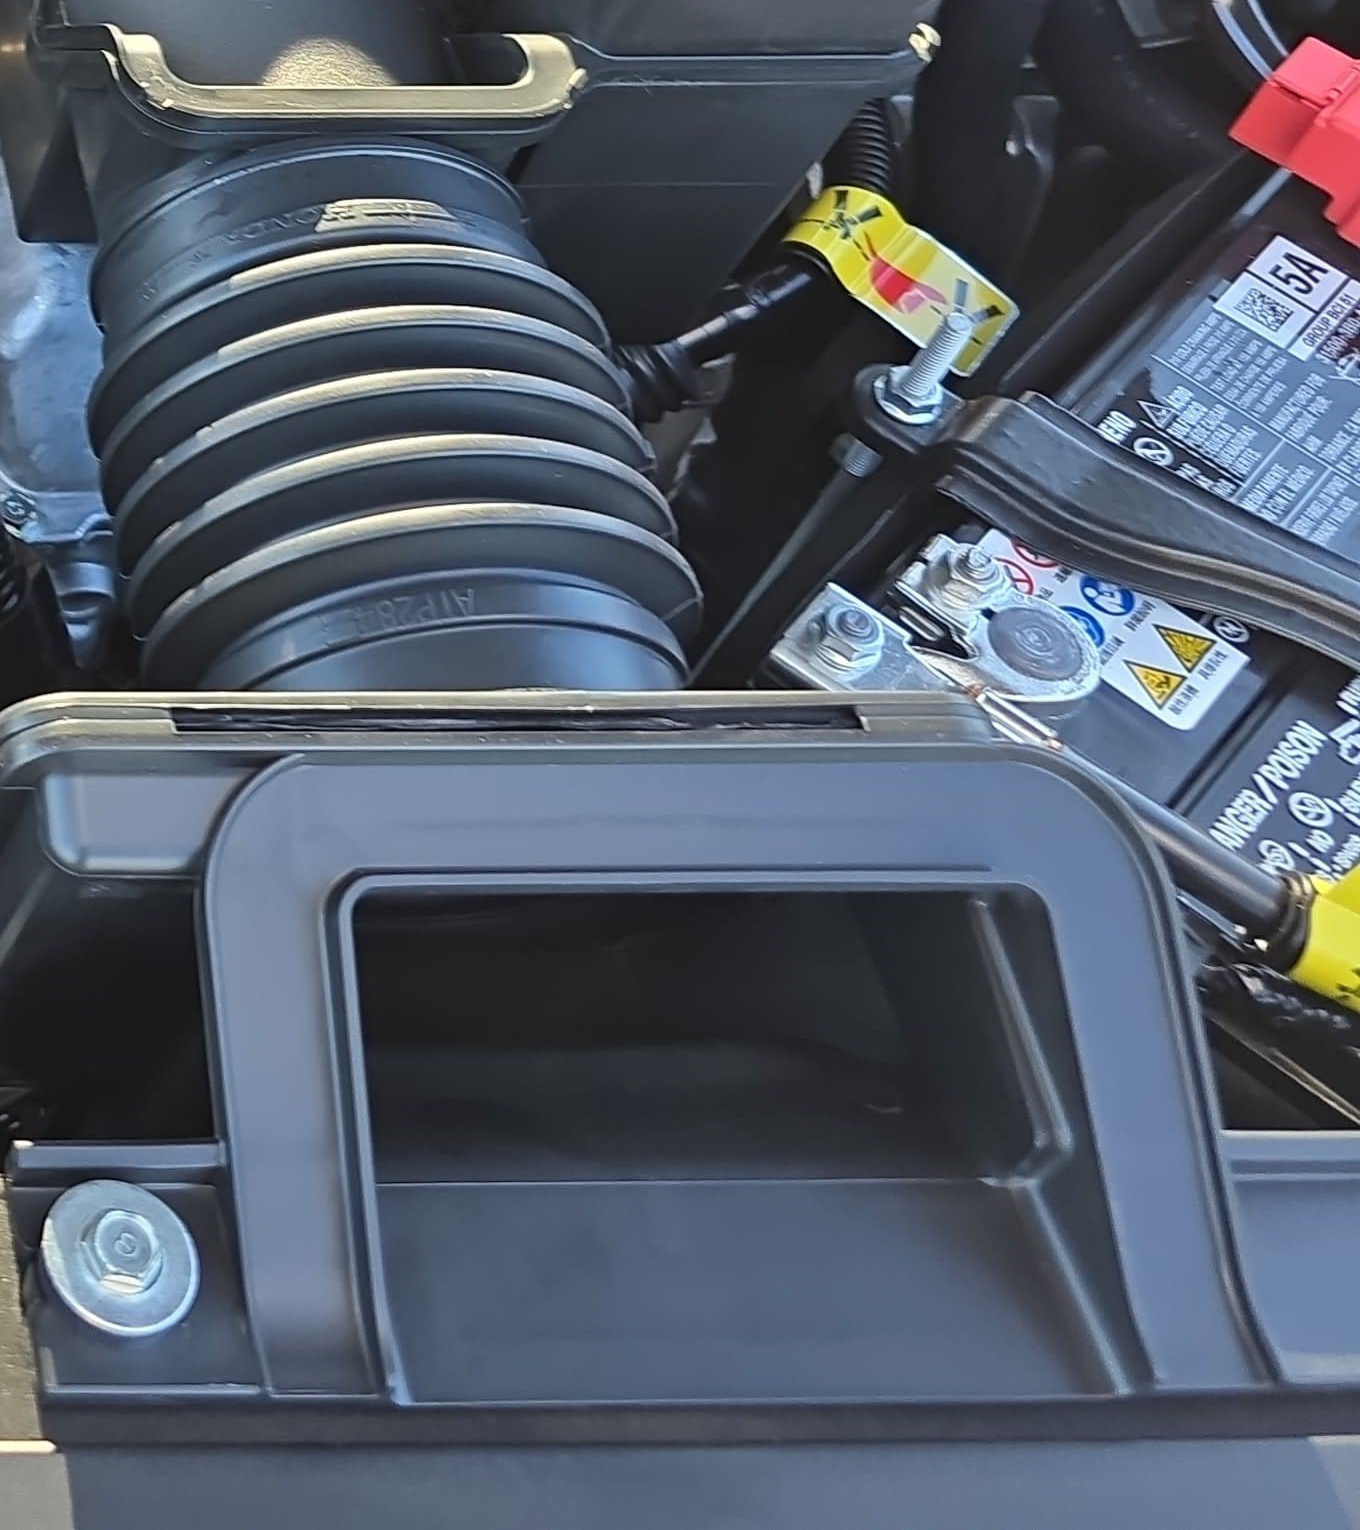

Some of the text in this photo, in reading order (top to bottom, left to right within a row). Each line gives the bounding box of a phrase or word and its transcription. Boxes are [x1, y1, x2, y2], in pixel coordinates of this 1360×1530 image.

[1266, 247, 1329, 297] 5A
[1300, 316, 1334, 347] GROUP
[1324, 301, 1347, 320] BCI
[1208, 718, 1329, 852] ANGER/POISON
